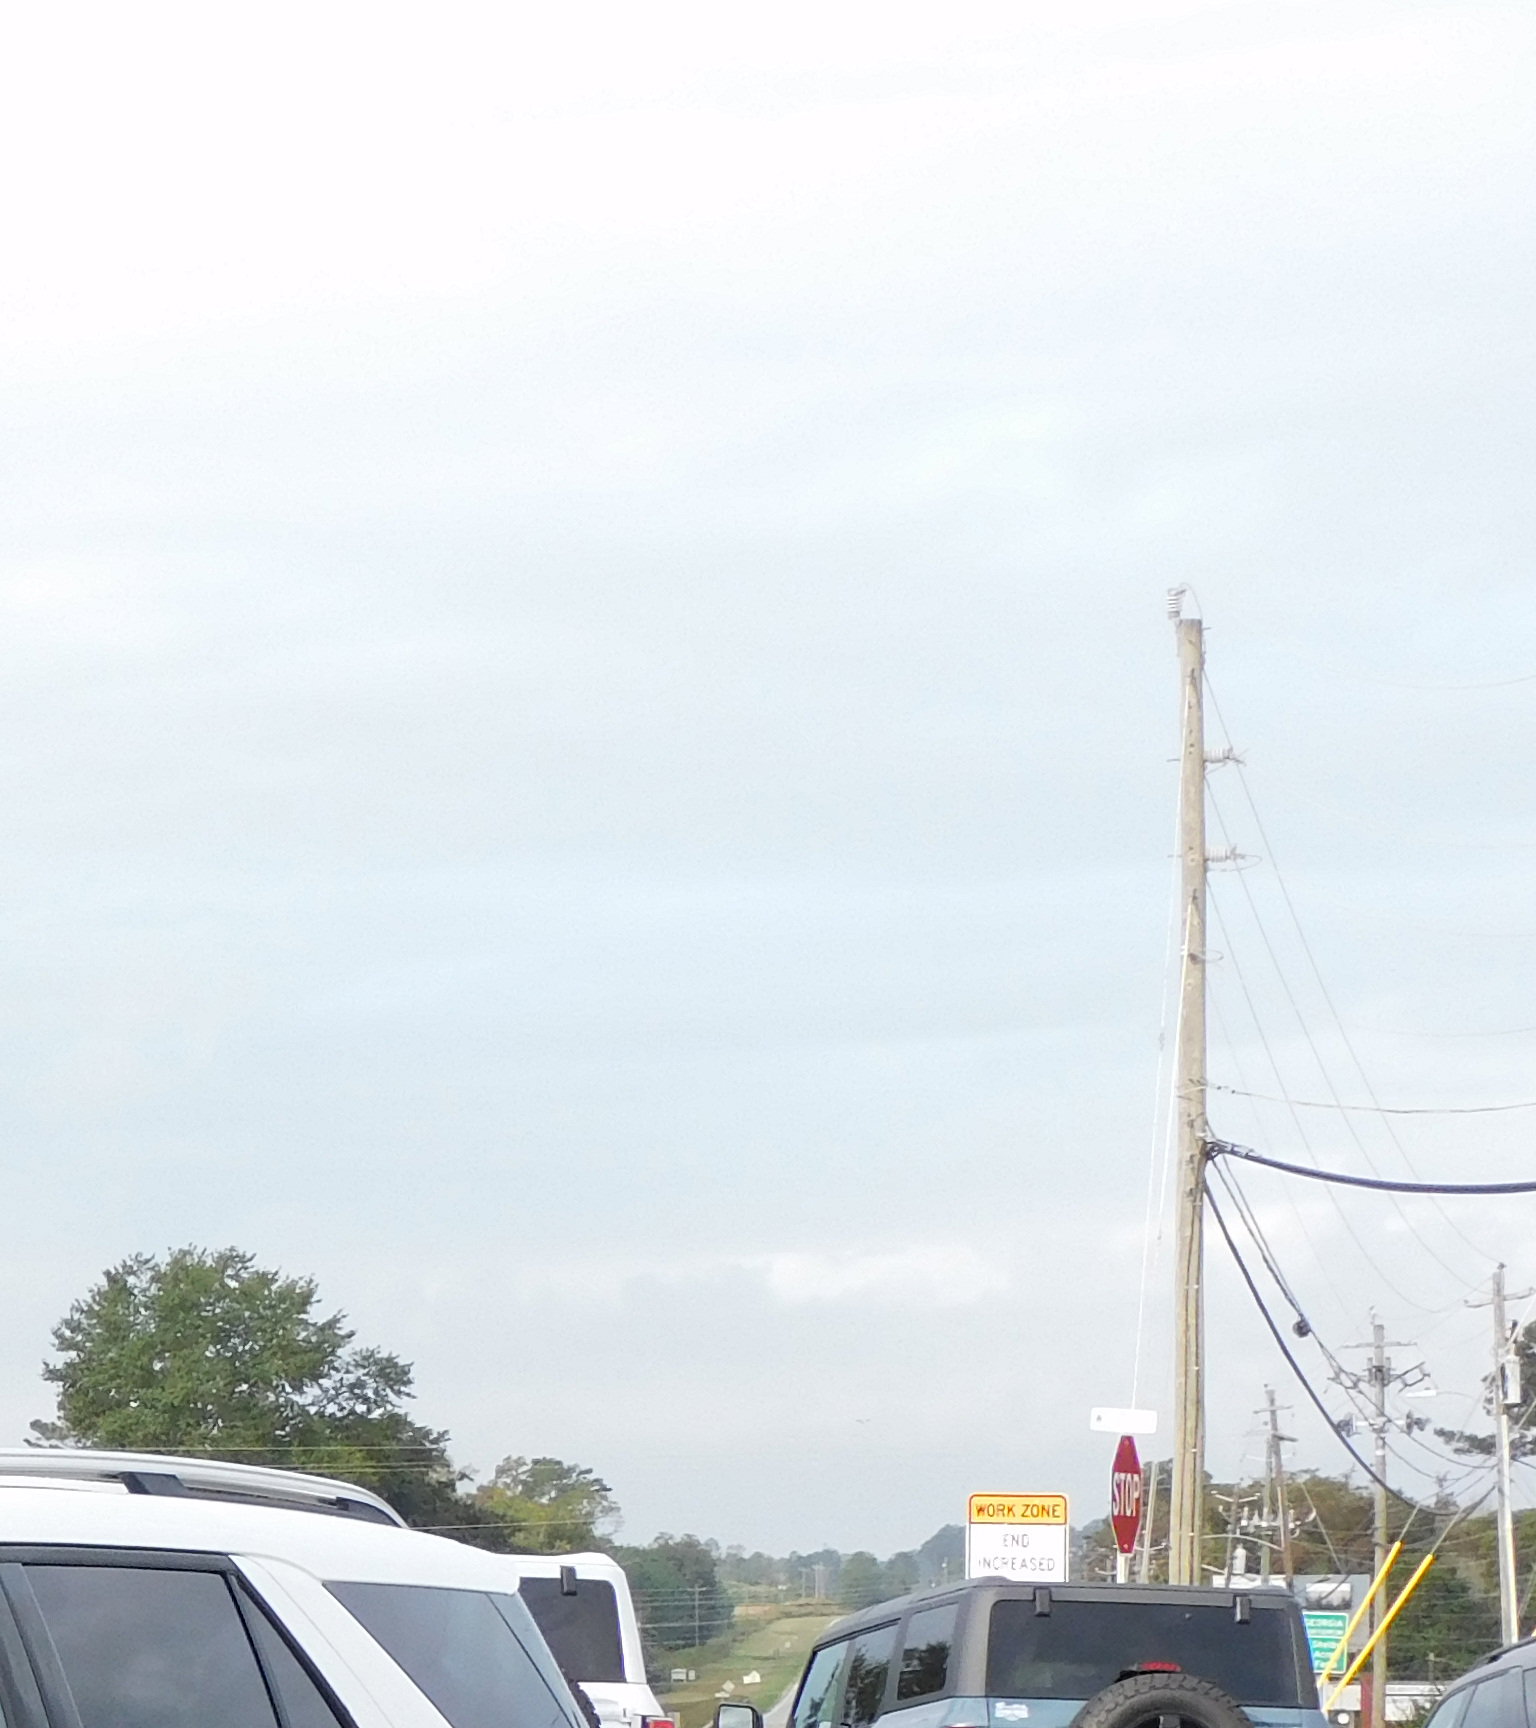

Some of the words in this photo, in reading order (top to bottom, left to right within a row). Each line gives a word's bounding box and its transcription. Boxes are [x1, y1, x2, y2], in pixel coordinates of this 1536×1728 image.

[1112, 1472, 1141, 1518] STOP
[975, 1503, 1016, 1518] WORK
[1020, 1503, 1061, 1519] ZONE
[1002, 1533, 1030, 1548] END
[978, 1556, 1056, 1572] INCREASED
